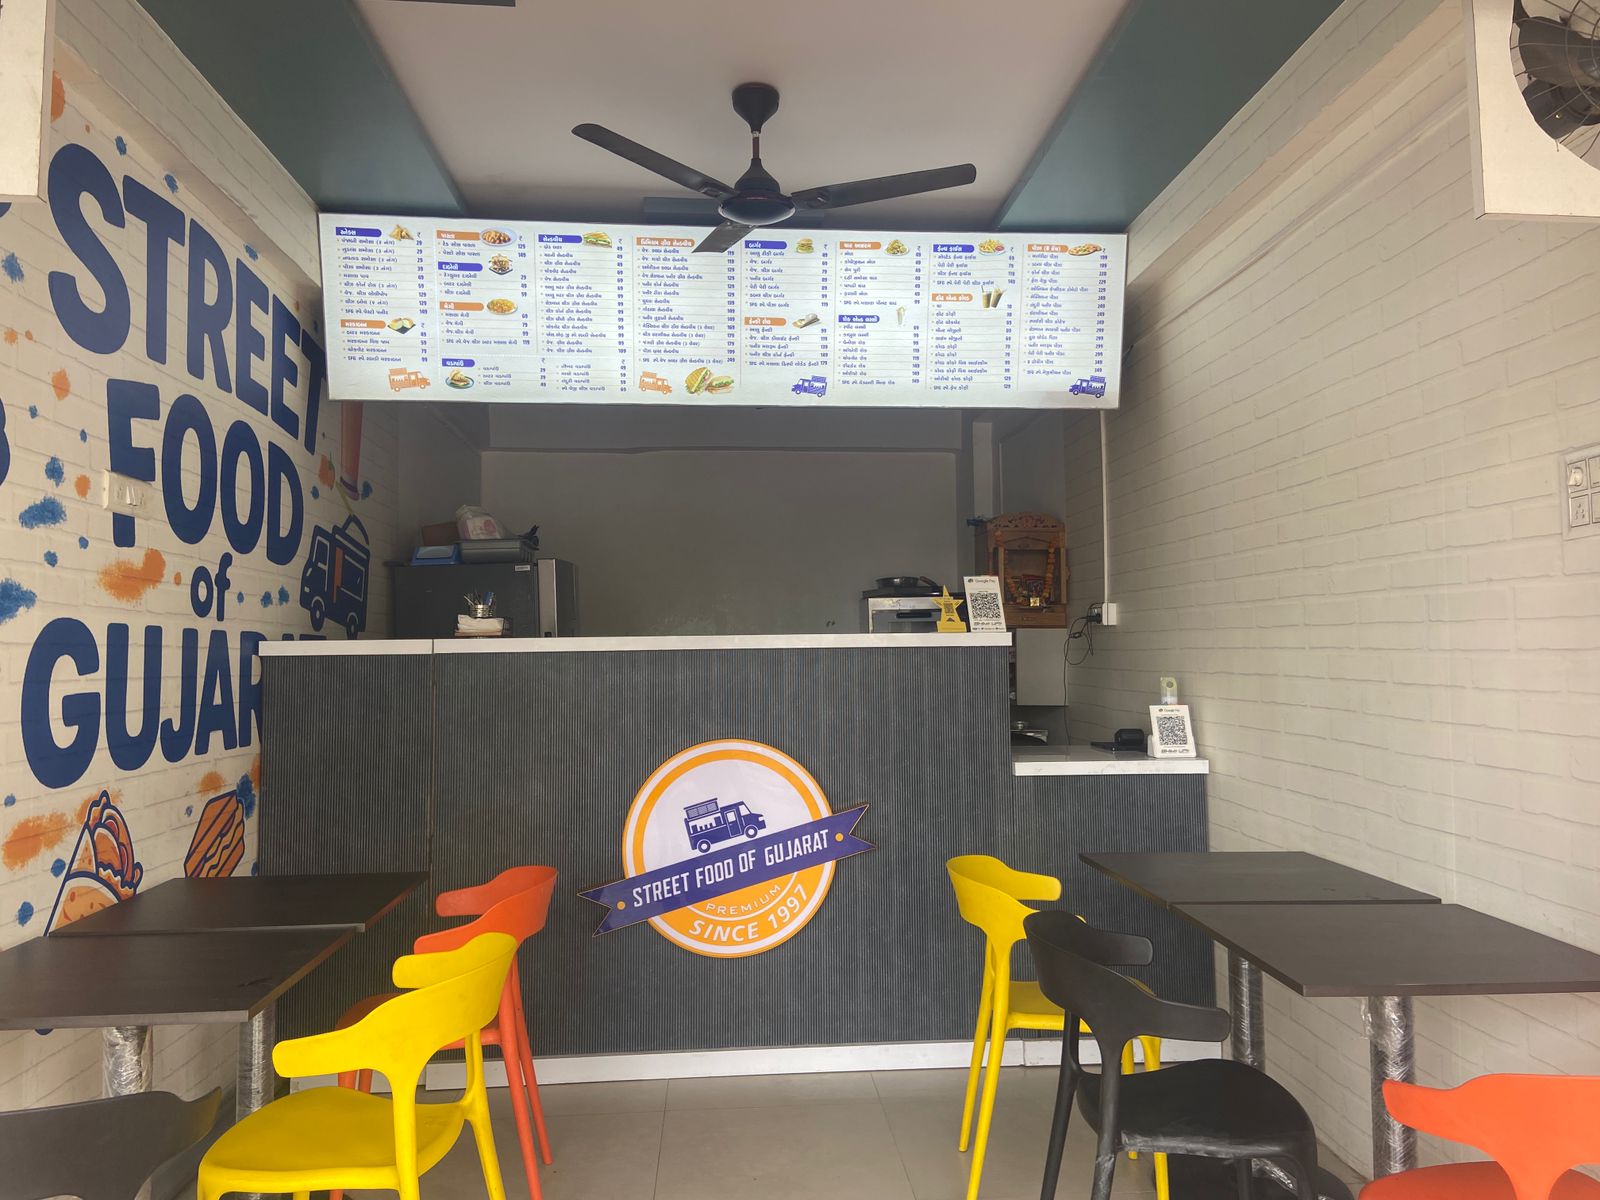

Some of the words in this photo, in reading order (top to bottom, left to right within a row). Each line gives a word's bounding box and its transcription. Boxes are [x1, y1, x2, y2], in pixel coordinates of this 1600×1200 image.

[48, 143, 325, 456] STREET
[106, 379, 304, 565] FOOD
[190, 552, 232, 621] of
[632, 872, 690, 908] STREET
[696, 862, 734, 888] FOOD
[739, 850, 757, 873] OF
[765, 829, 828, 866] GUJARAT
[706, 884, 781, 916] PREMIUM
[689, 919, 760, 942] SINCE
[768, 883, 808, 930] 1997
